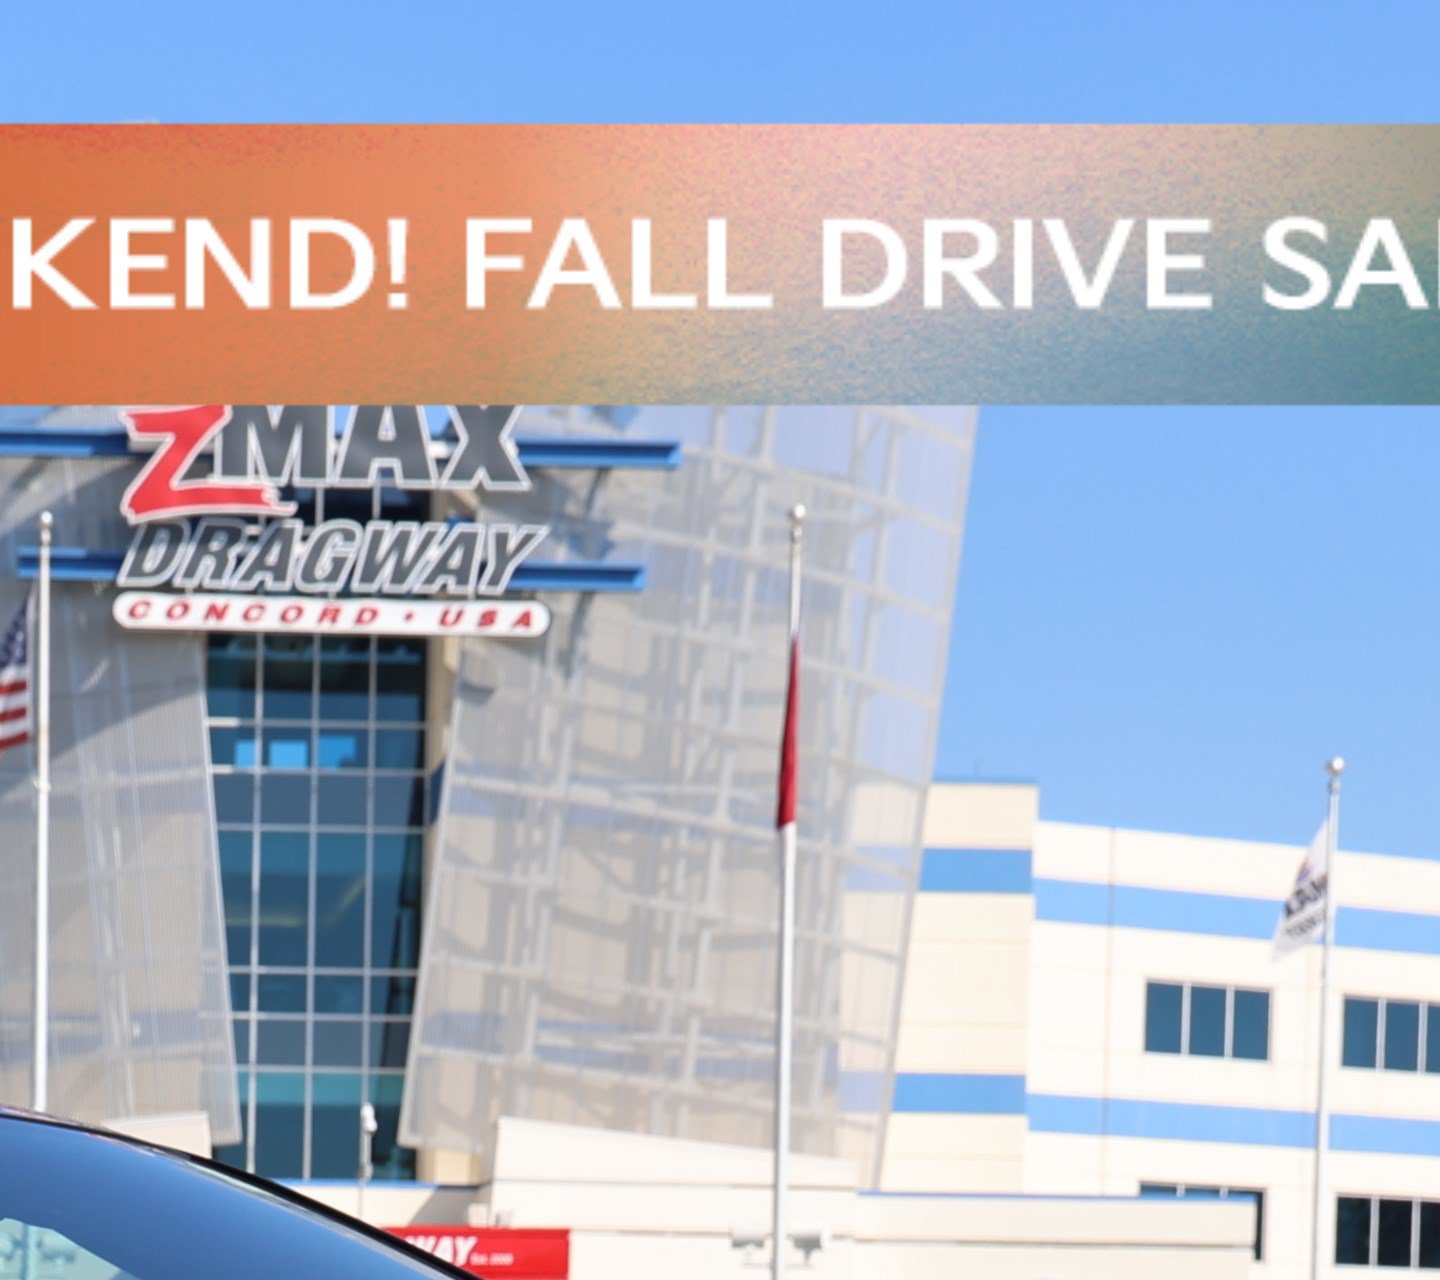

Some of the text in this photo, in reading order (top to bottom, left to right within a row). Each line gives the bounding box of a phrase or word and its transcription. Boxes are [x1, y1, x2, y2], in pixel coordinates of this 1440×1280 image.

[116, 518, 551, 597] DRAGWAY
[126, 597, 534, 630] CONCORD USA
